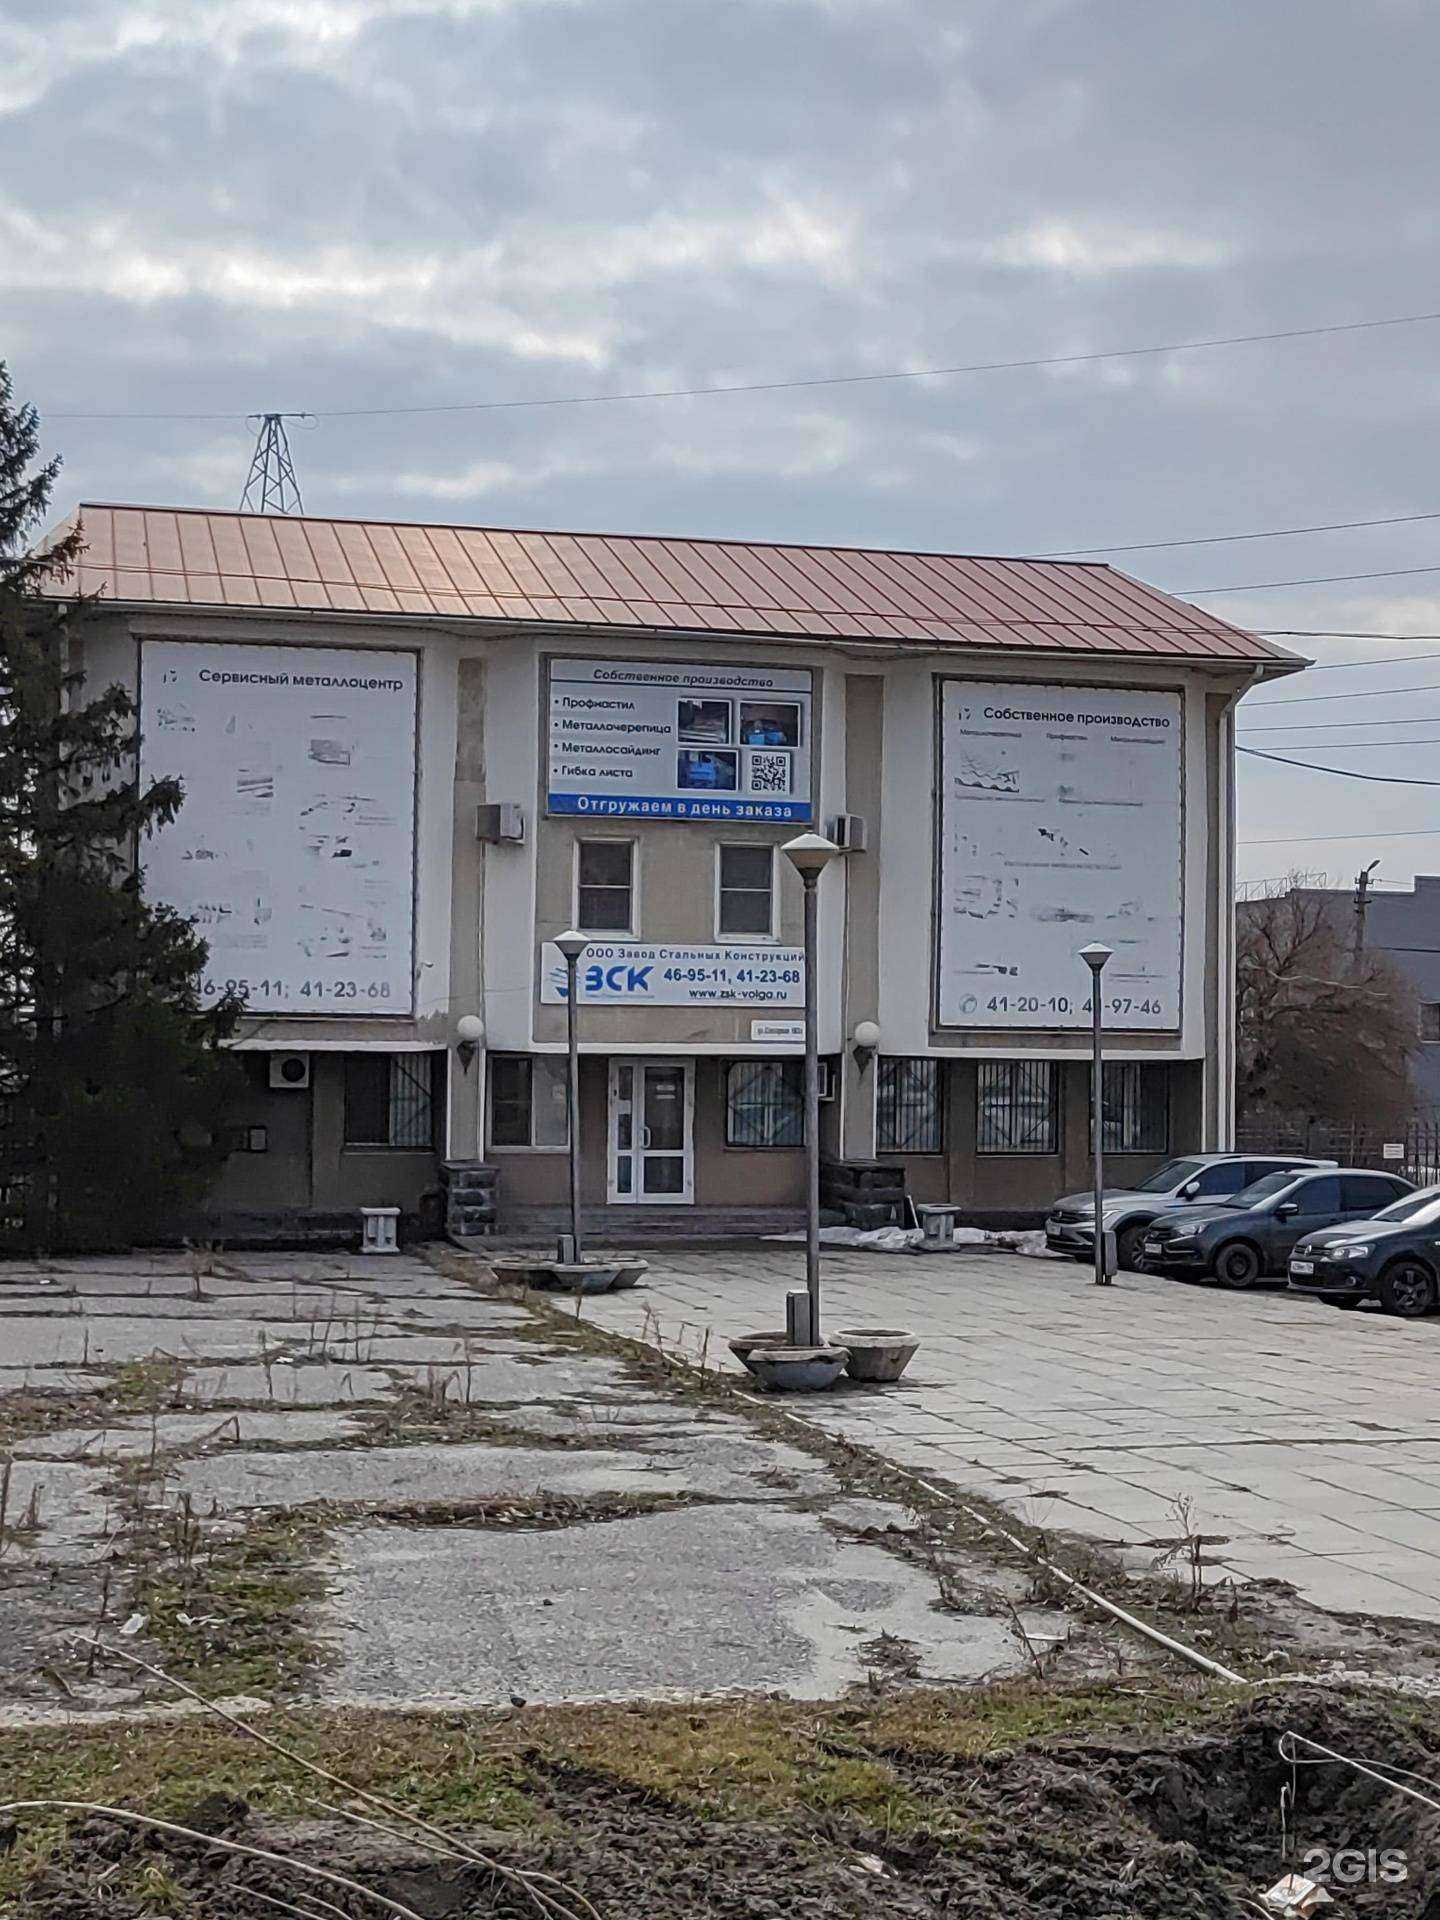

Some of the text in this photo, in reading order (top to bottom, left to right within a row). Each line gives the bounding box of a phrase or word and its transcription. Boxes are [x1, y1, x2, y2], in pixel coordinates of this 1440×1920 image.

[199, 669, 404, 692] Сервисный металлоцентр
[593, 668, 774, 688] Собственное производство
[562, 696, 636, 711] Профнастил
[562, 719, 672, 735] Металлочерепица
[983, 706, 1170, 729] Собственное производство
[561, 742, 661, 757] Металлосайдинг
[561, 764, 634, 779] Гибка листа
[578, 796, 793, 818] Отгружаем в день заказа
[586, 947, 614, 959] ООО
[618, 948, 656, 960] Завод
[659, 948, 721, 961] Стальных
[585, 965, 801, 992] ЗСК 46-95-11, 41-23-68
[299, 980, 391, 999] 41-23-68
[986, 996, 1162, 1015] 41-20-10; 4-97-46
